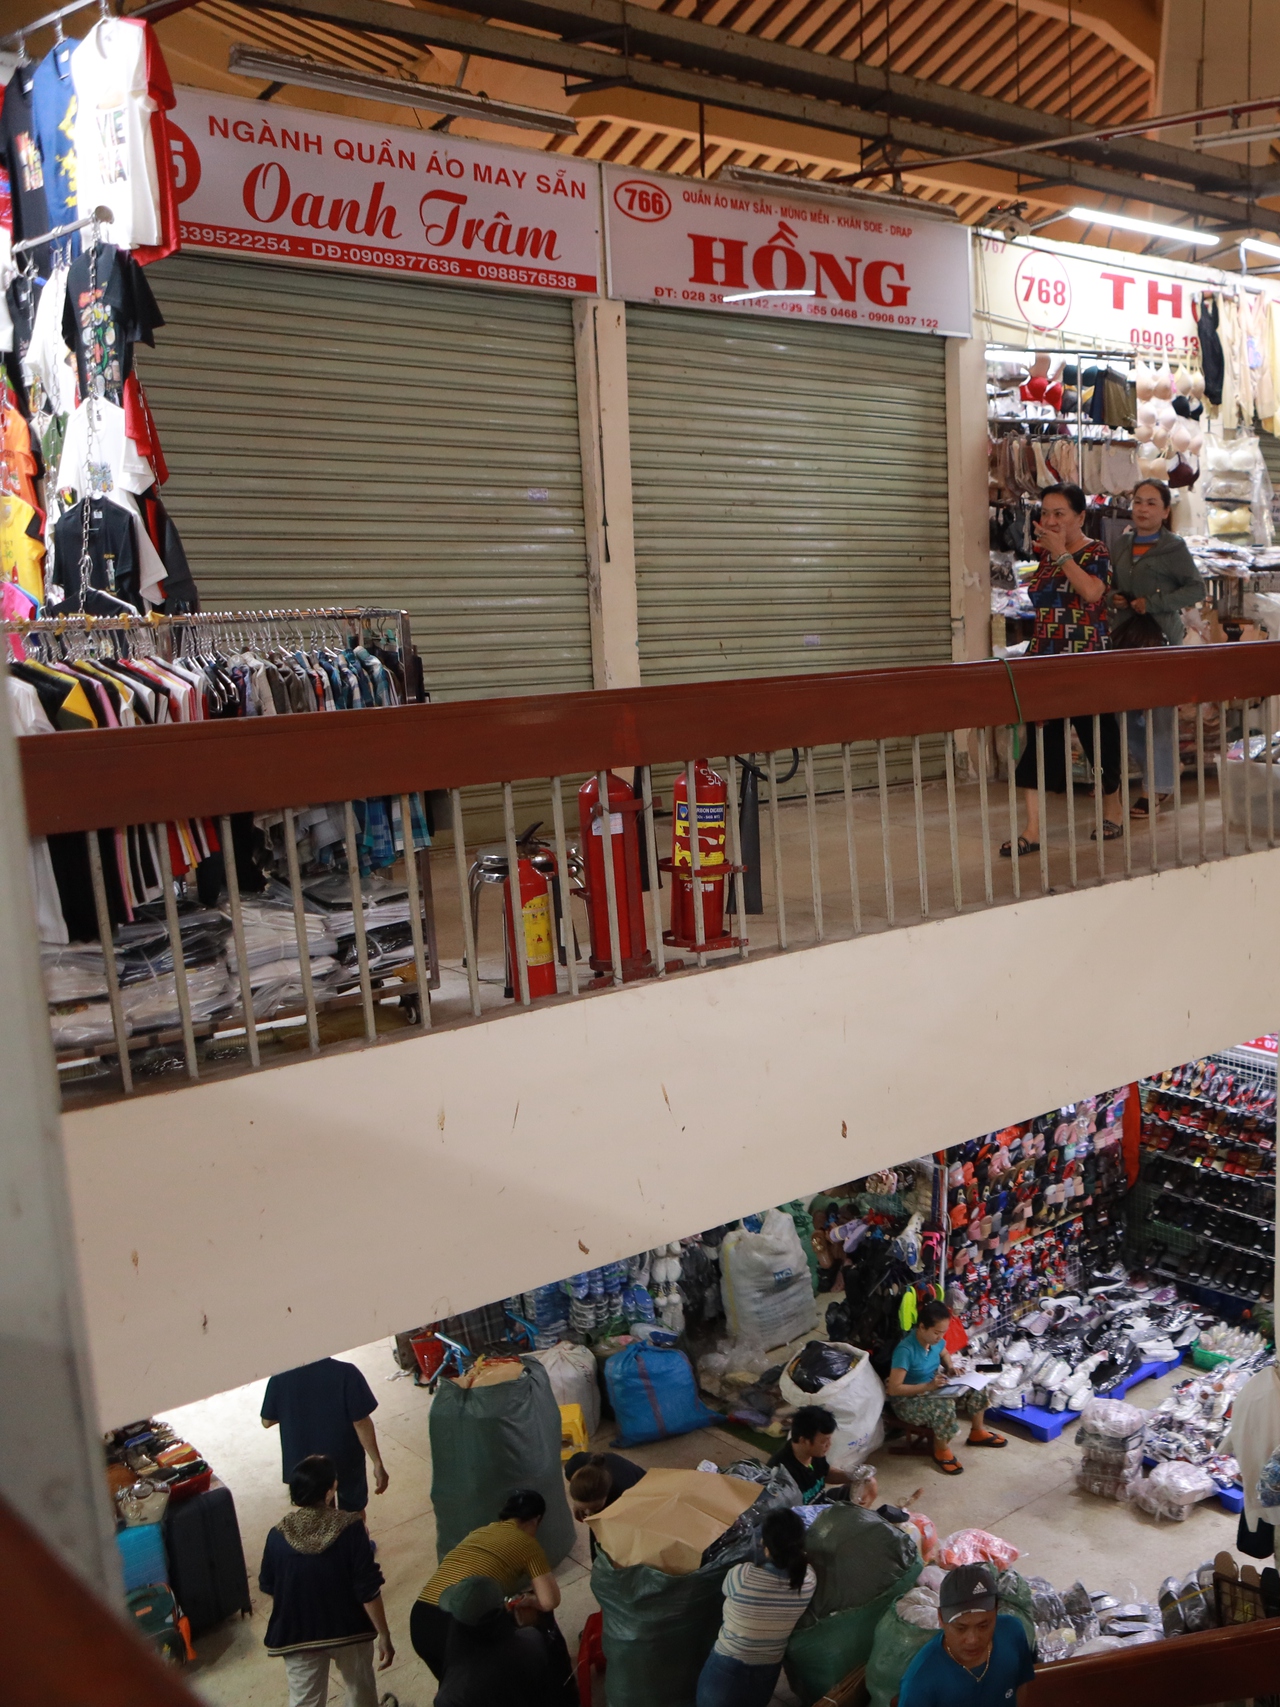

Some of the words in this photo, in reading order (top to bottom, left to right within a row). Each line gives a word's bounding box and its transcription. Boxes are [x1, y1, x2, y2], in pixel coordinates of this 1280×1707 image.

[208, 115, 323, 155] NGÀNH
[333, 138, 416, 171] QUẦN
[426, 150, 465, 178] ÁO
[473, 163, 527, 189] MAY
[536, 169, 586, 199] SẴN
[243, 162, 402, 239] Oanh
[419, 189, 562, 261] Trâm
[625, 188, 664, 215] 766
[714, 193, 728, 209] ÁO
[730, 198, 750, 212] MAY
[780, 206, 807, 221] MÙNG
[863, 220, 883, 234] SOIE
[890, 225, 912, 238] DRAP
[477, 264, 577, 289] 0988576538
[687, 221, 912, 308] HỒNG
[654, 286, 677, 299] ĐT:
[682, 290, 705, 301] 028
[831, 307, 858, 319] 0468
[869, 312, 895, 324] 0908
[898, 316, 917, 326] 037
[921, 318, 938, 329] 122
[1021, 276, 1067, 307] 768
[1130, 328, 1175, 352] 0908
[706, 775, 721, 786] 34
